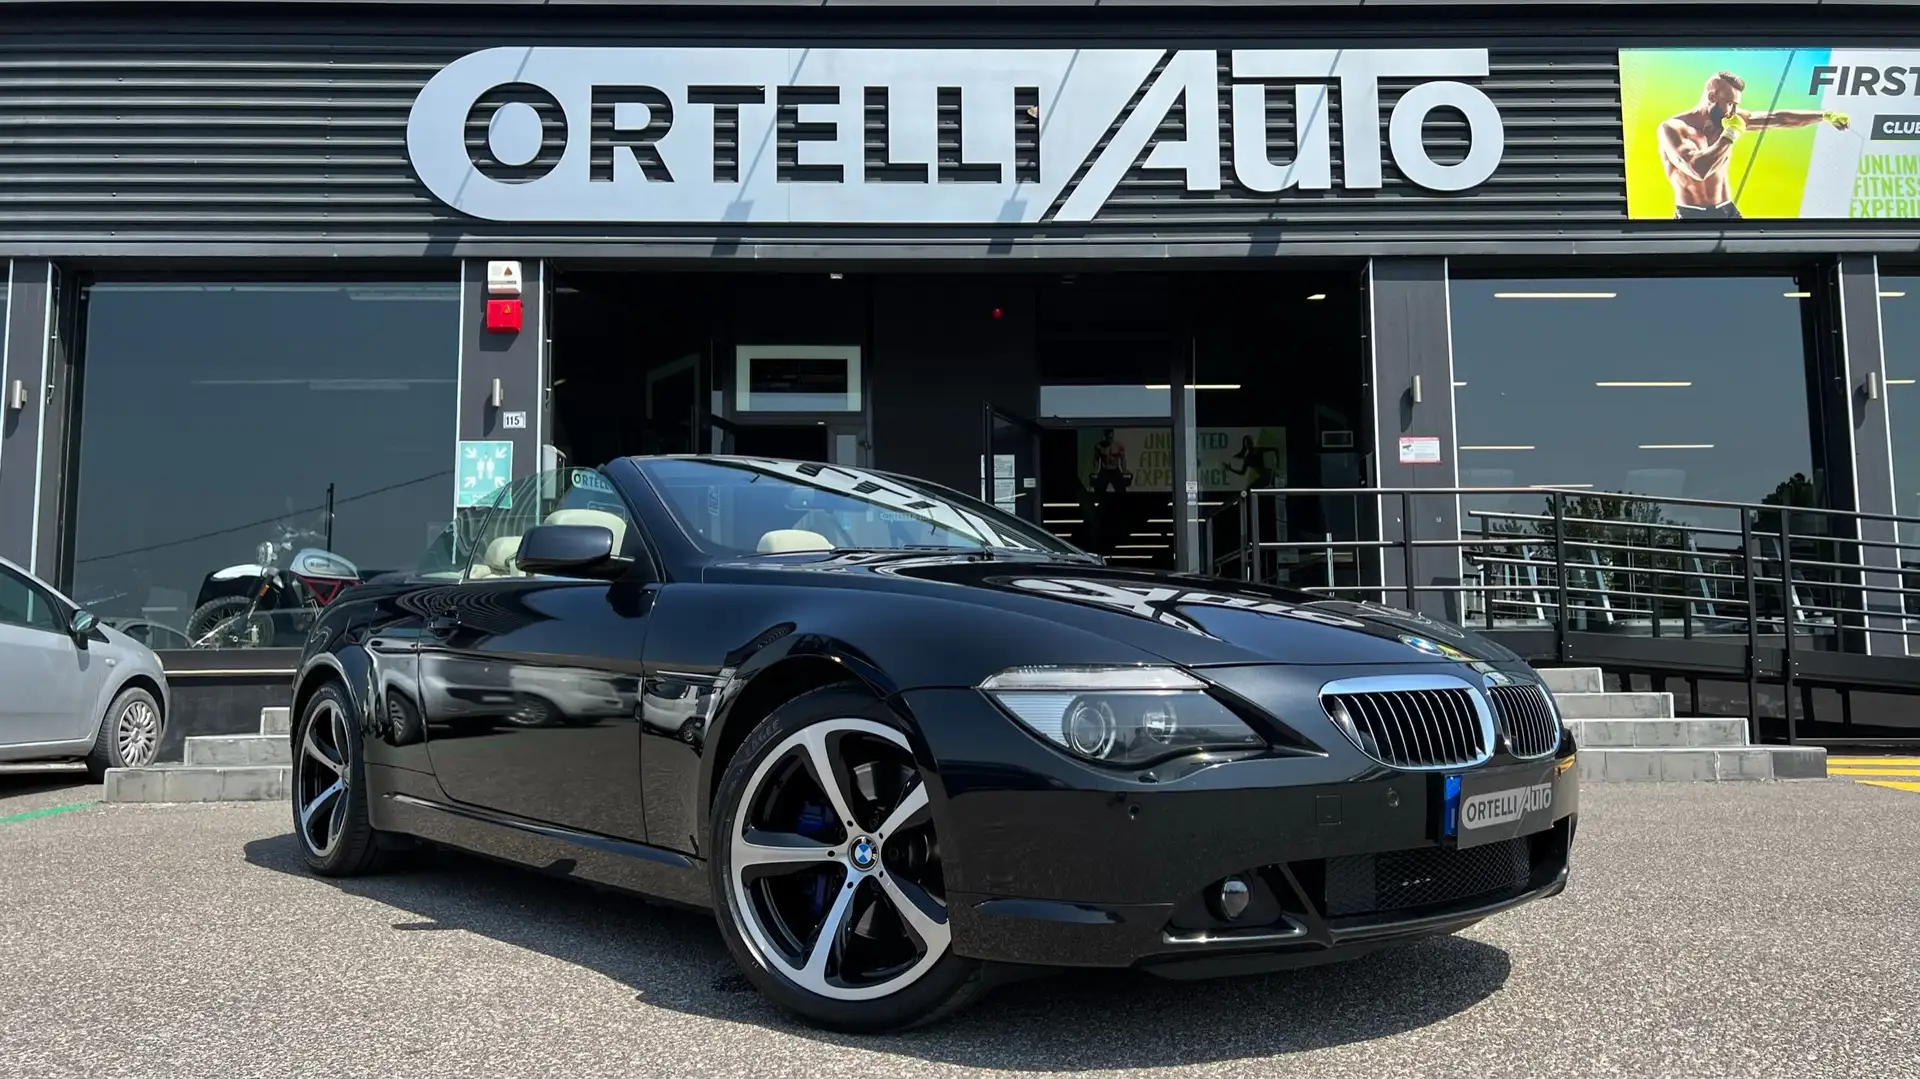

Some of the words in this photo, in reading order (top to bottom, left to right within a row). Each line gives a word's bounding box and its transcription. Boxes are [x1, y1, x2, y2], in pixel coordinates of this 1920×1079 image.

[464, 81, 1041, 185] ORTELLI
[1858, 154, 1920, 175] UNLIM
[1849, 198, 1920, 218] EXPERI
[1466, 795, 1517, 823] ORTELLI
